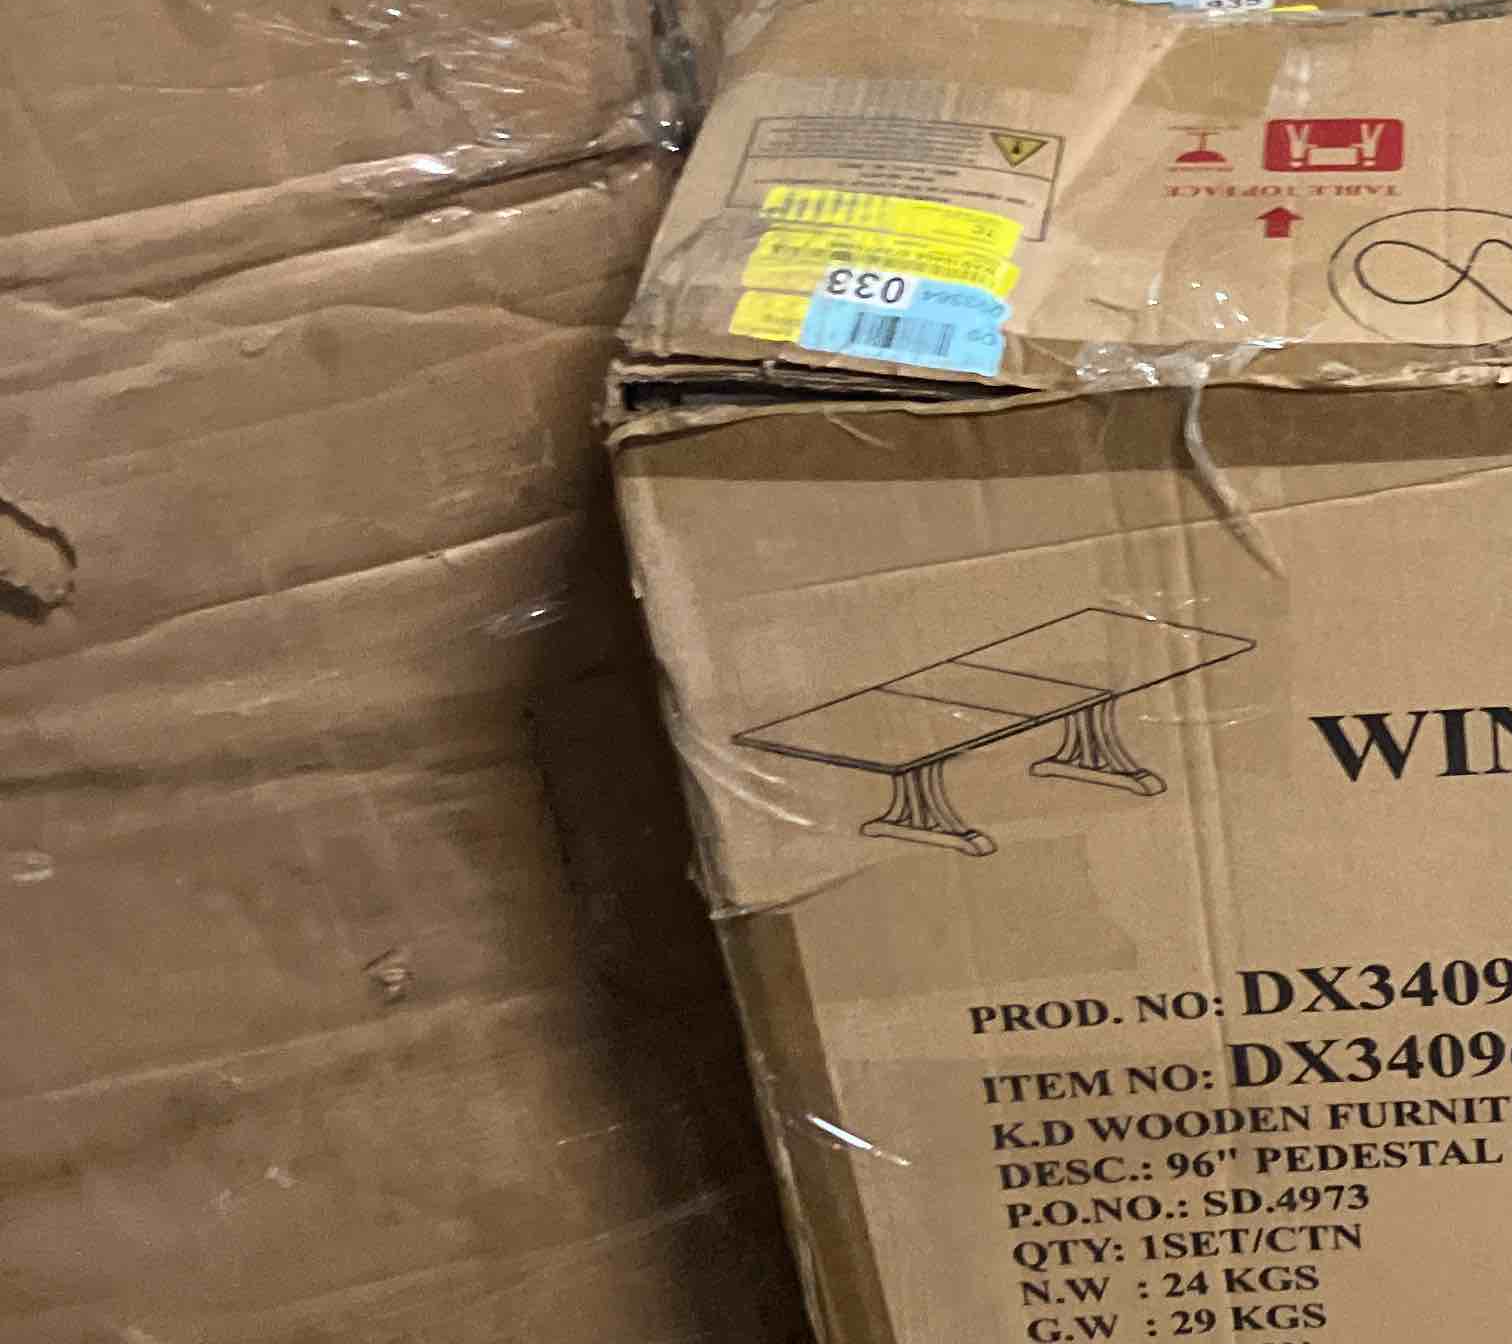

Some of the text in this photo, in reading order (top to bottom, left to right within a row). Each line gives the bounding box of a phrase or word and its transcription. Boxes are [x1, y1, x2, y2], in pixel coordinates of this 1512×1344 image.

[1308, 184, 1401, 198] TABLE
[826, 267, 906, 305] 033
[969, 997, 1123, 1034] PROD.
[1136, 991, 1226, 1024] NO:
[982, 1068, 1113, 1105] ITEM
[1127, 1063, 1215, 1095] NO:
[990, 1118, 1074, 1151] K.D
[1086, 1104, 1311, 1144] WOODEN
[997, 1159, 1154, 1191] DESC.:
[1255, 1137, 1504, 1175] PEDESTAL
[1007, 1184, 1370, 1229] P.O.NO.: SD.4973
[1012, 1223, 1363, 1274] QTY: 1SET/CTN
[1020, 1276, 1110, 1307] N.W
[1161, 1271, 1209, 1300] 24
[1223, 1264, 1320, 1294] KGS
[1027, 1314, 1119, 1344] G.W
[1170, 1308, 1216, 1338] 29
[1231, 1302, 1327, 1333] KGS
